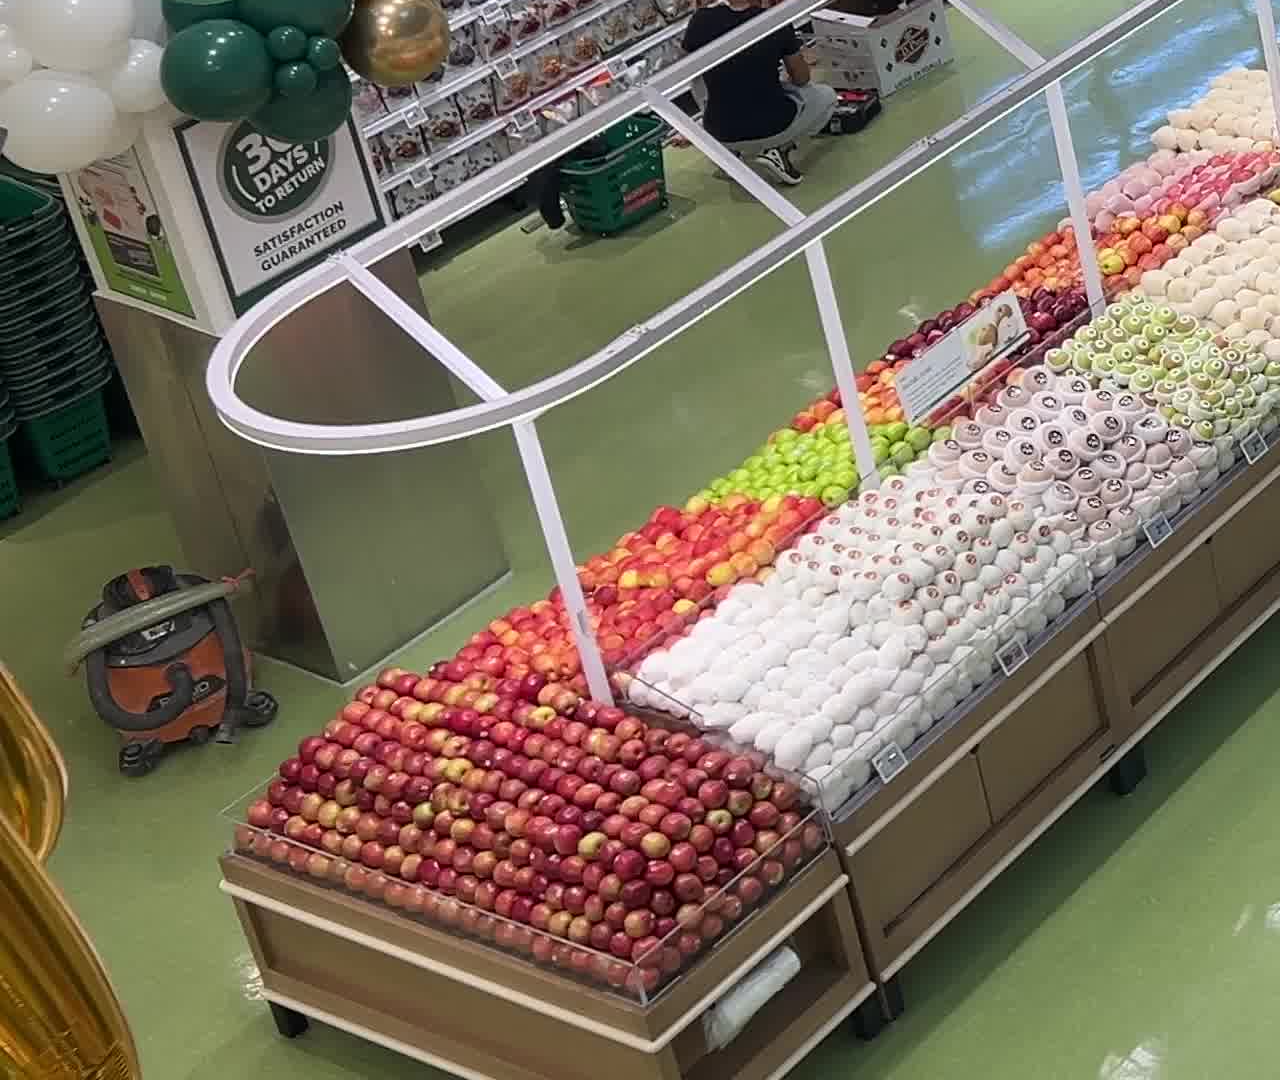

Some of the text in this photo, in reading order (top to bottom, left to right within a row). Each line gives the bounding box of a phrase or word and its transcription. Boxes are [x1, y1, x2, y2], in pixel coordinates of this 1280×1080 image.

[253, 144, 309, 193] DAYS
[255, 156, 325, 213] TO RETURN
[254, 200, 344, 257] SATISFACTION
[261, 218, 347, 271] GUARANTEED
